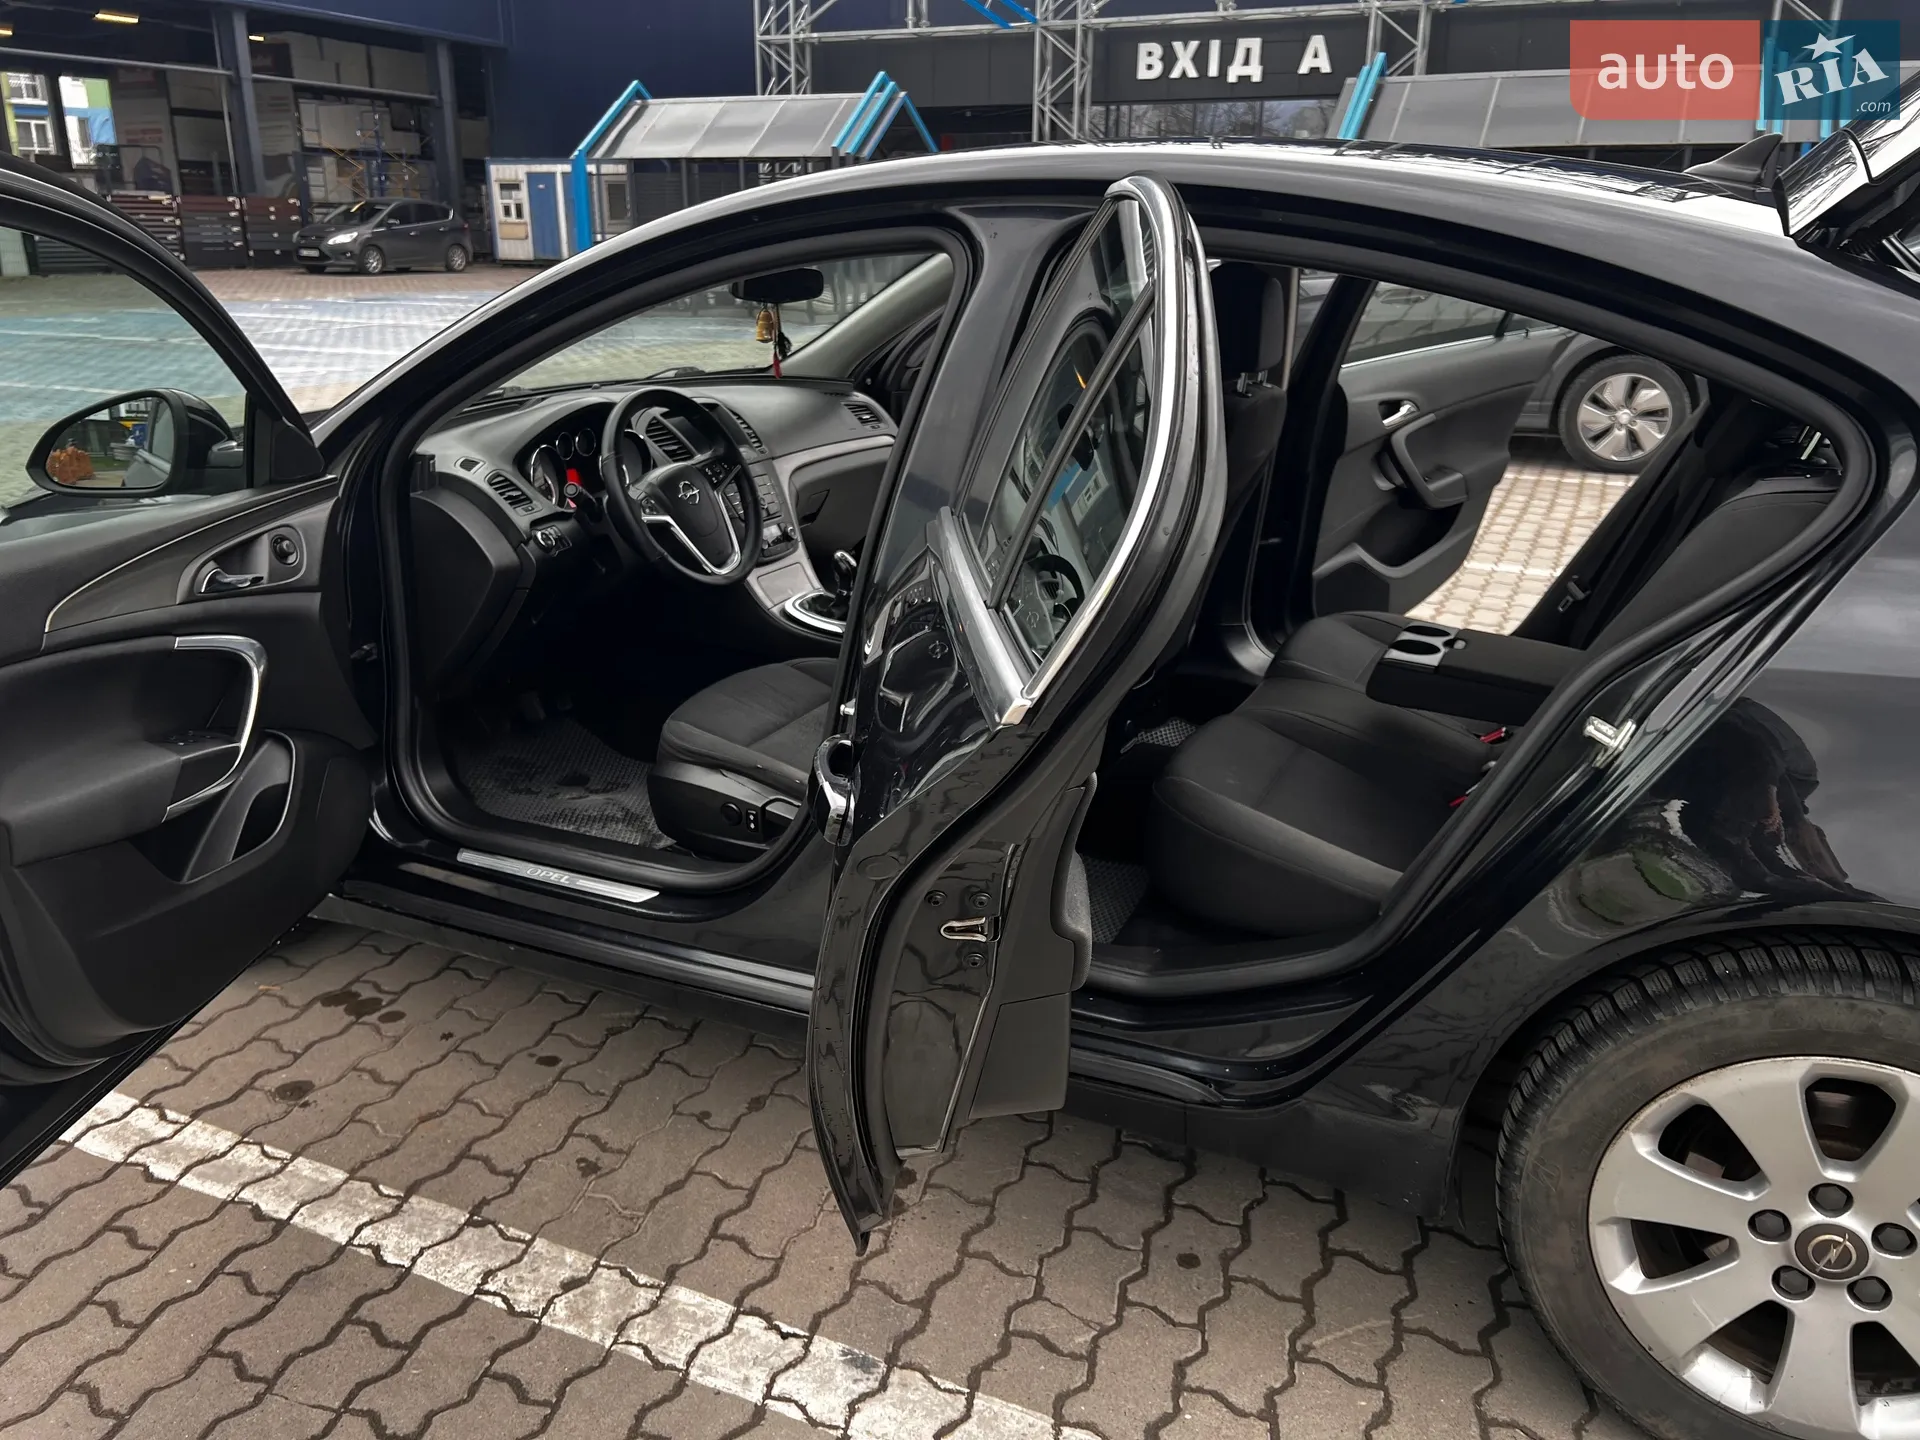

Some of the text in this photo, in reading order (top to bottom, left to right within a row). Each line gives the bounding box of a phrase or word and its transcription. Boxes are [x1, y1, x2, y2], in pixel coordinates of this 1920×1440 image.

[1136, 34, 1333, 84] ВХІД А
[526, 866, 571, 884] OPEL
